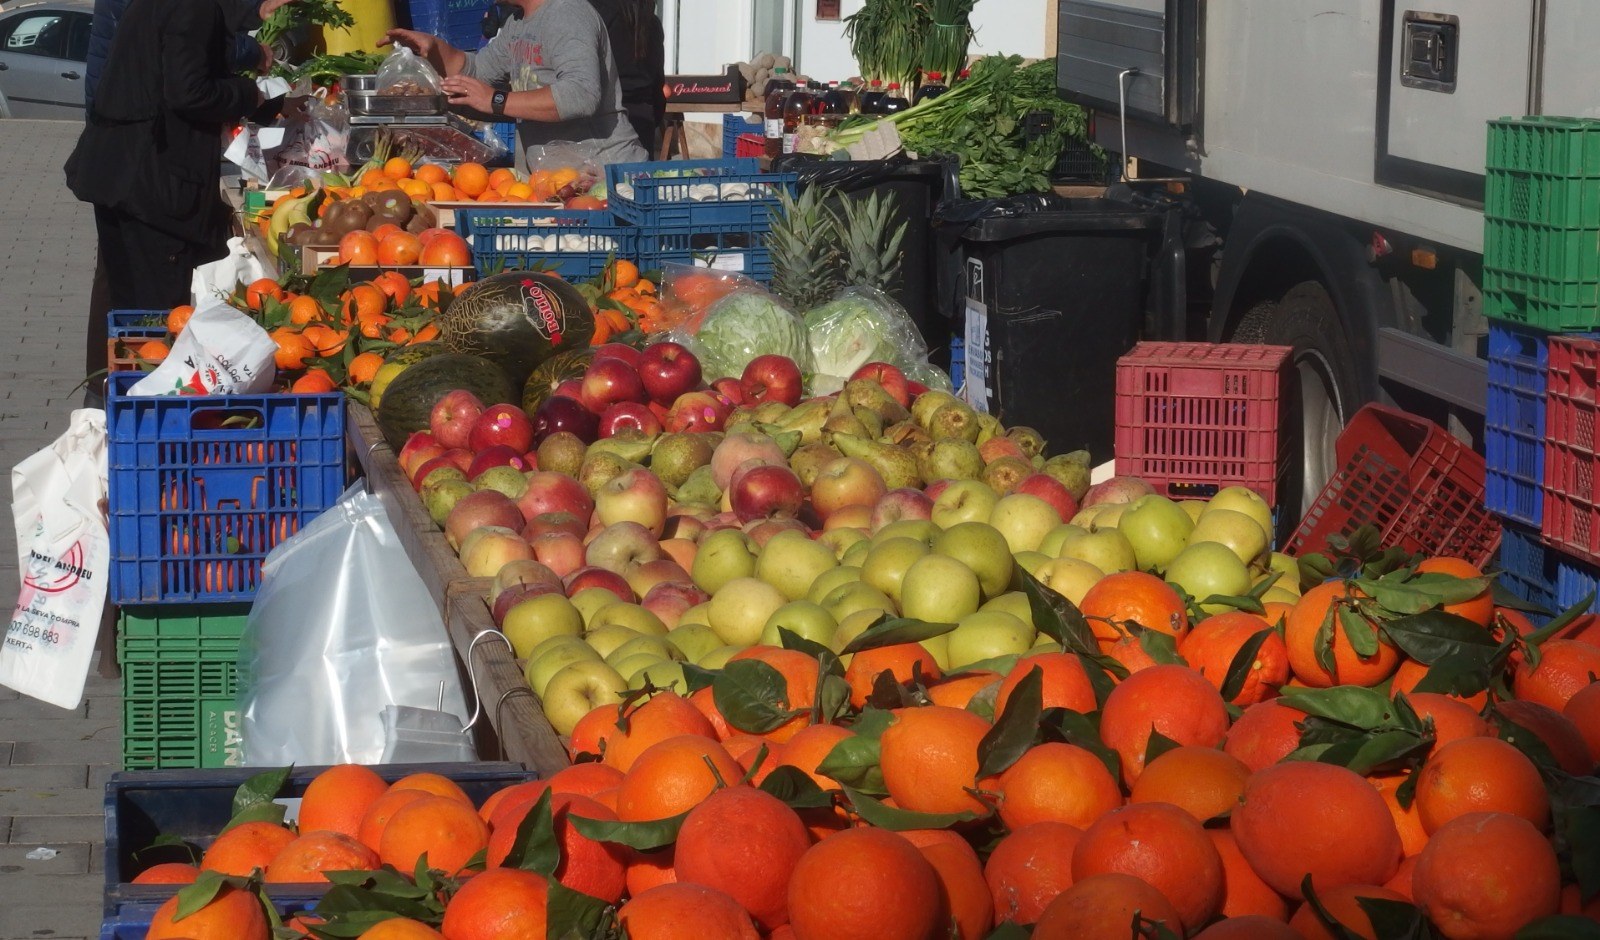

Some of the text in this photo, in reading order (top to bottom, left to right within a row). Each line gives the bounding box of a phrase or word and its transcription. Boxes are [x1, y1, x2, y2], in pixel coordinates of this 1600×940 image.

[529, 286, 560, 333] BOLLO
[54, 560, 93, 580] ANDREU
[21, 605, 30, 613] LA
[31, 608, 49, 618] SEVA
[50, 615, 80, 628] COMPRA
[6, 636, 33, 651] XERTA
[22, 623, 41, 638] 698
[41, 630, 60, 644] 683
